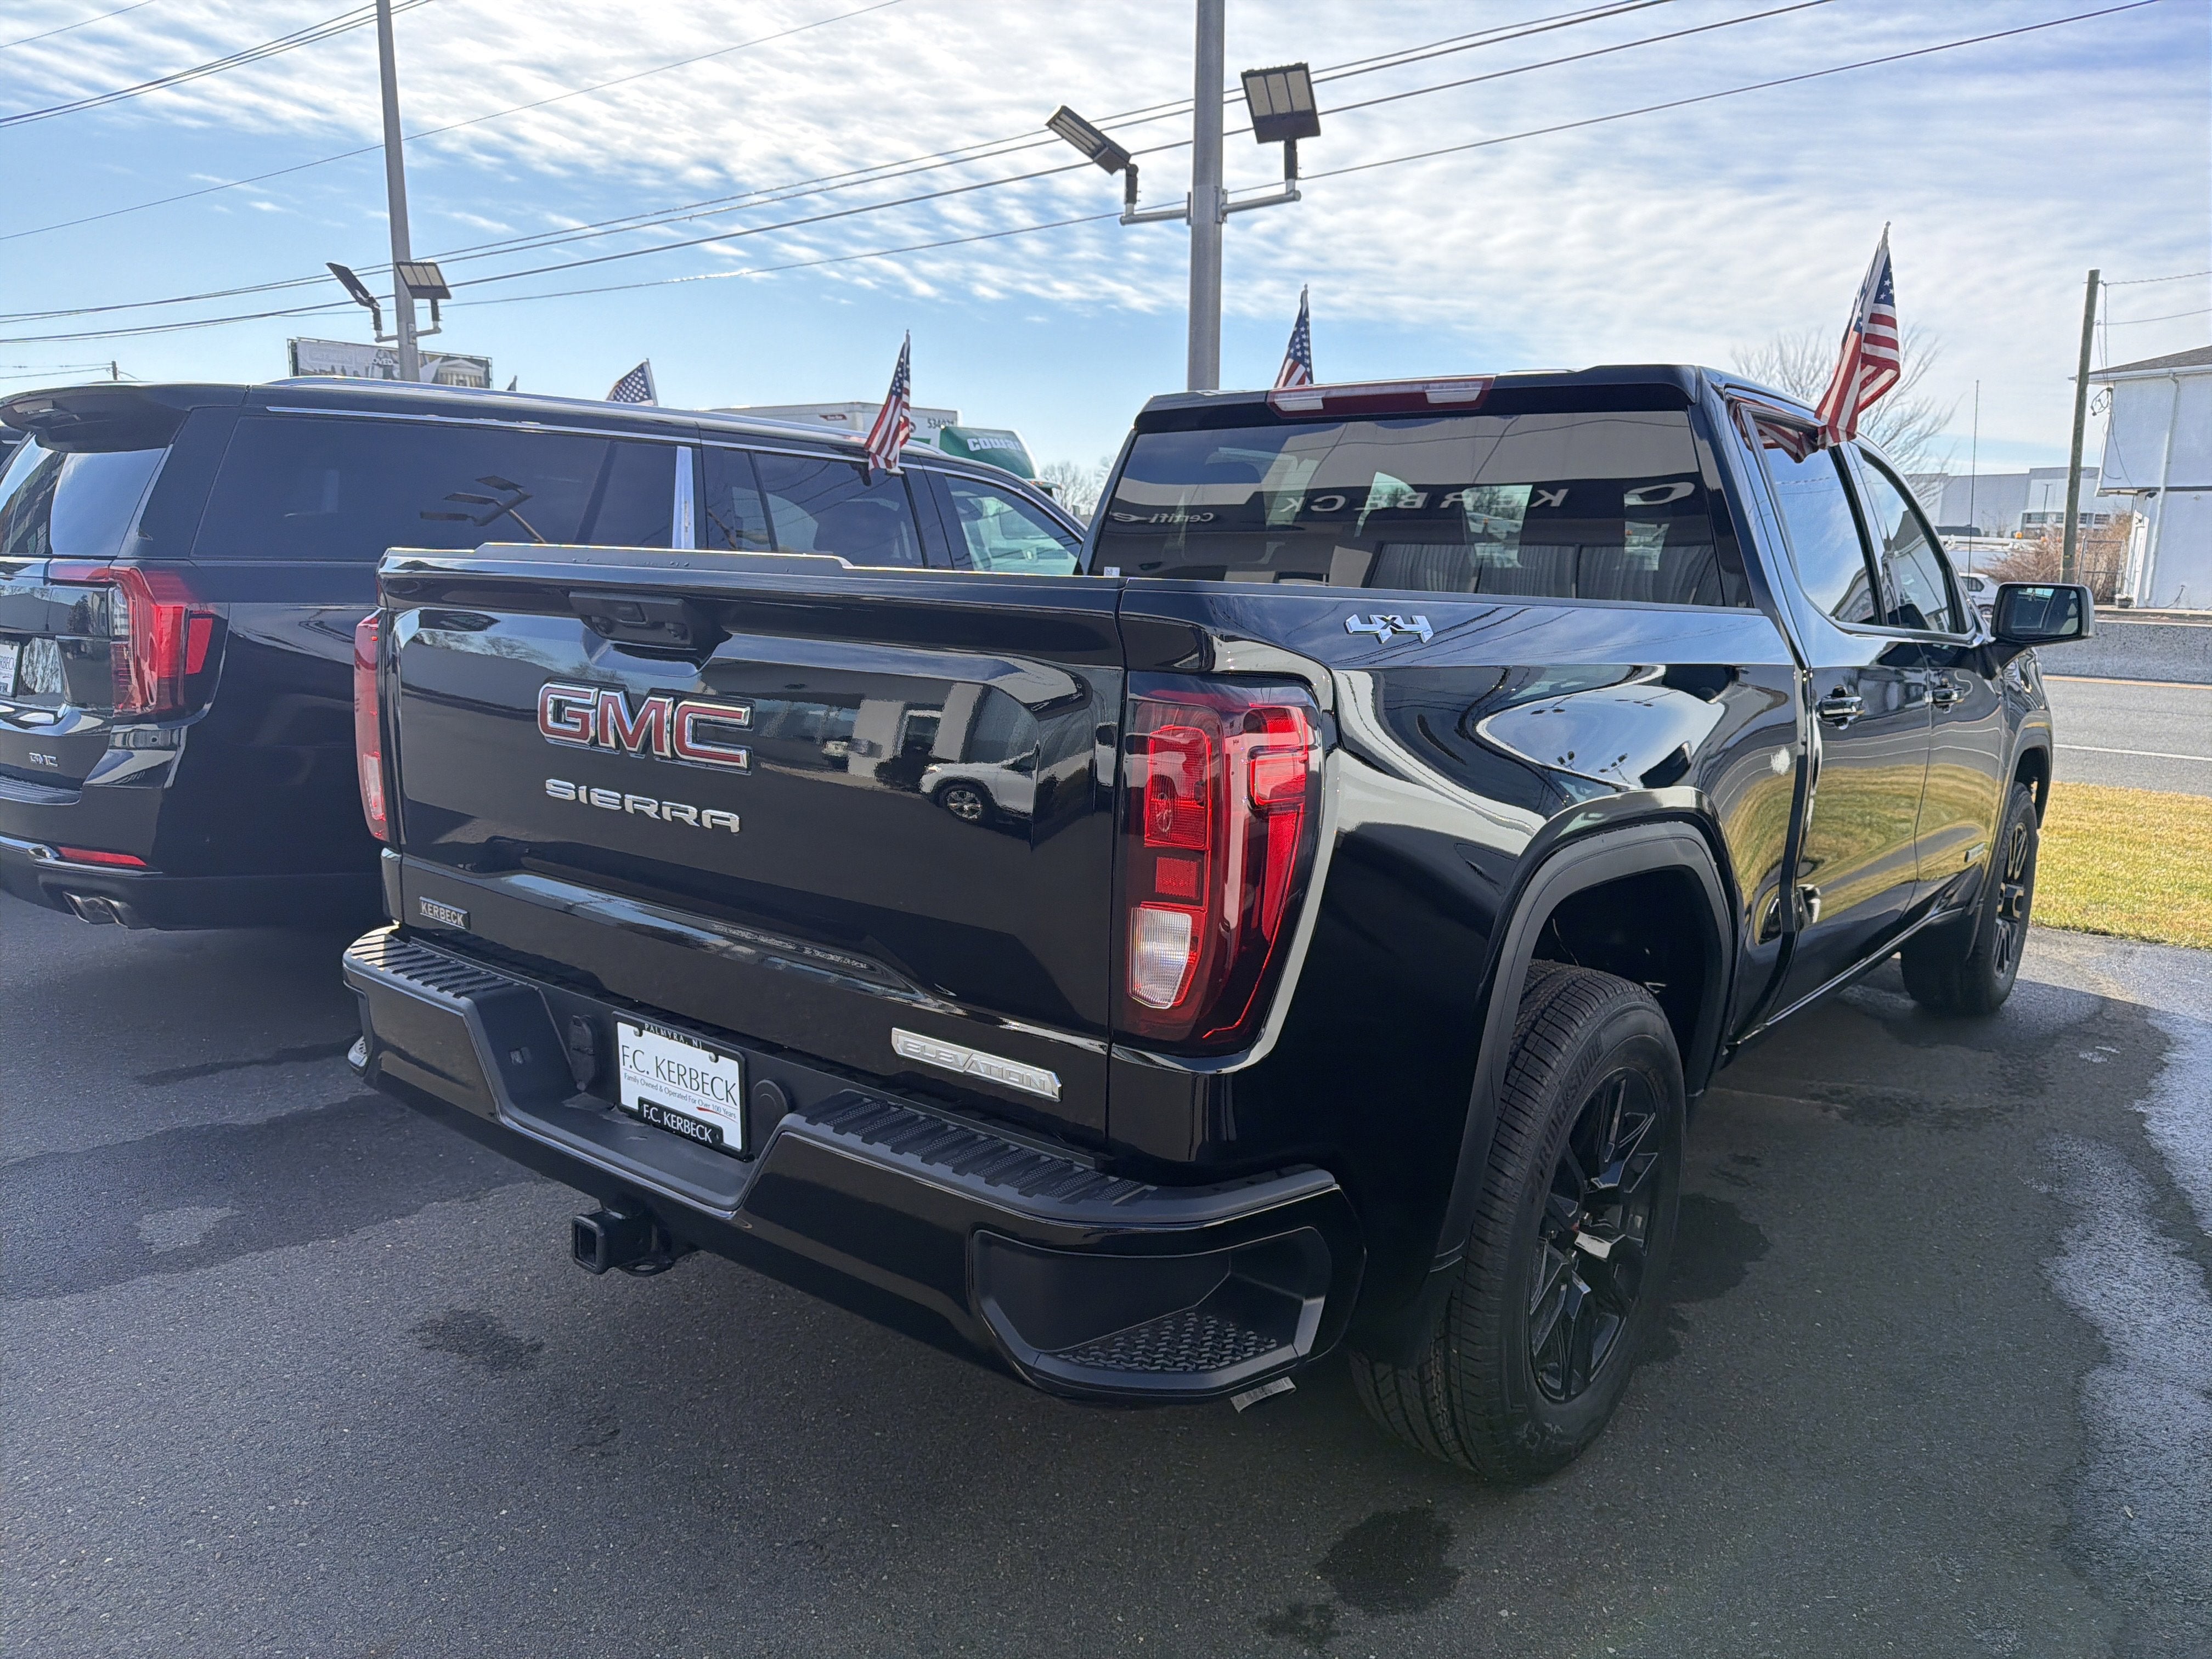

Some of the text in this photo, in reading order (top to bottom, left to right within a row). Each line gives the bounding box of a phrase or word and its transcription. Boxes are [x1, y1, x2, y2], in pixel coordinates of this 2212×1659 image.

[538, 681, 753, 769] GMC
[545, 778, 741, 834] SIERRA
[420, 900, 465, 927] KERBECK
[692, 1039, 703, 1049] NJ
[903, 1037, 1046, 1092] ELEVATION
[622, 1044, 738, 1107] F.C. KERBECK
[624, 1073, 639, 1085] Family
[640, 1078, 658, 1091] Owned
[664, 1087, 687, 1101] Operated
[689, 1095, 697, 1105] For
[697, 1099, 710, 1108] Over
[712, 1103, 721, 1113] 100
[722, 1107, 737, 1119] Years
[643, 1104, 713, 1144] F.C. KERBECK
